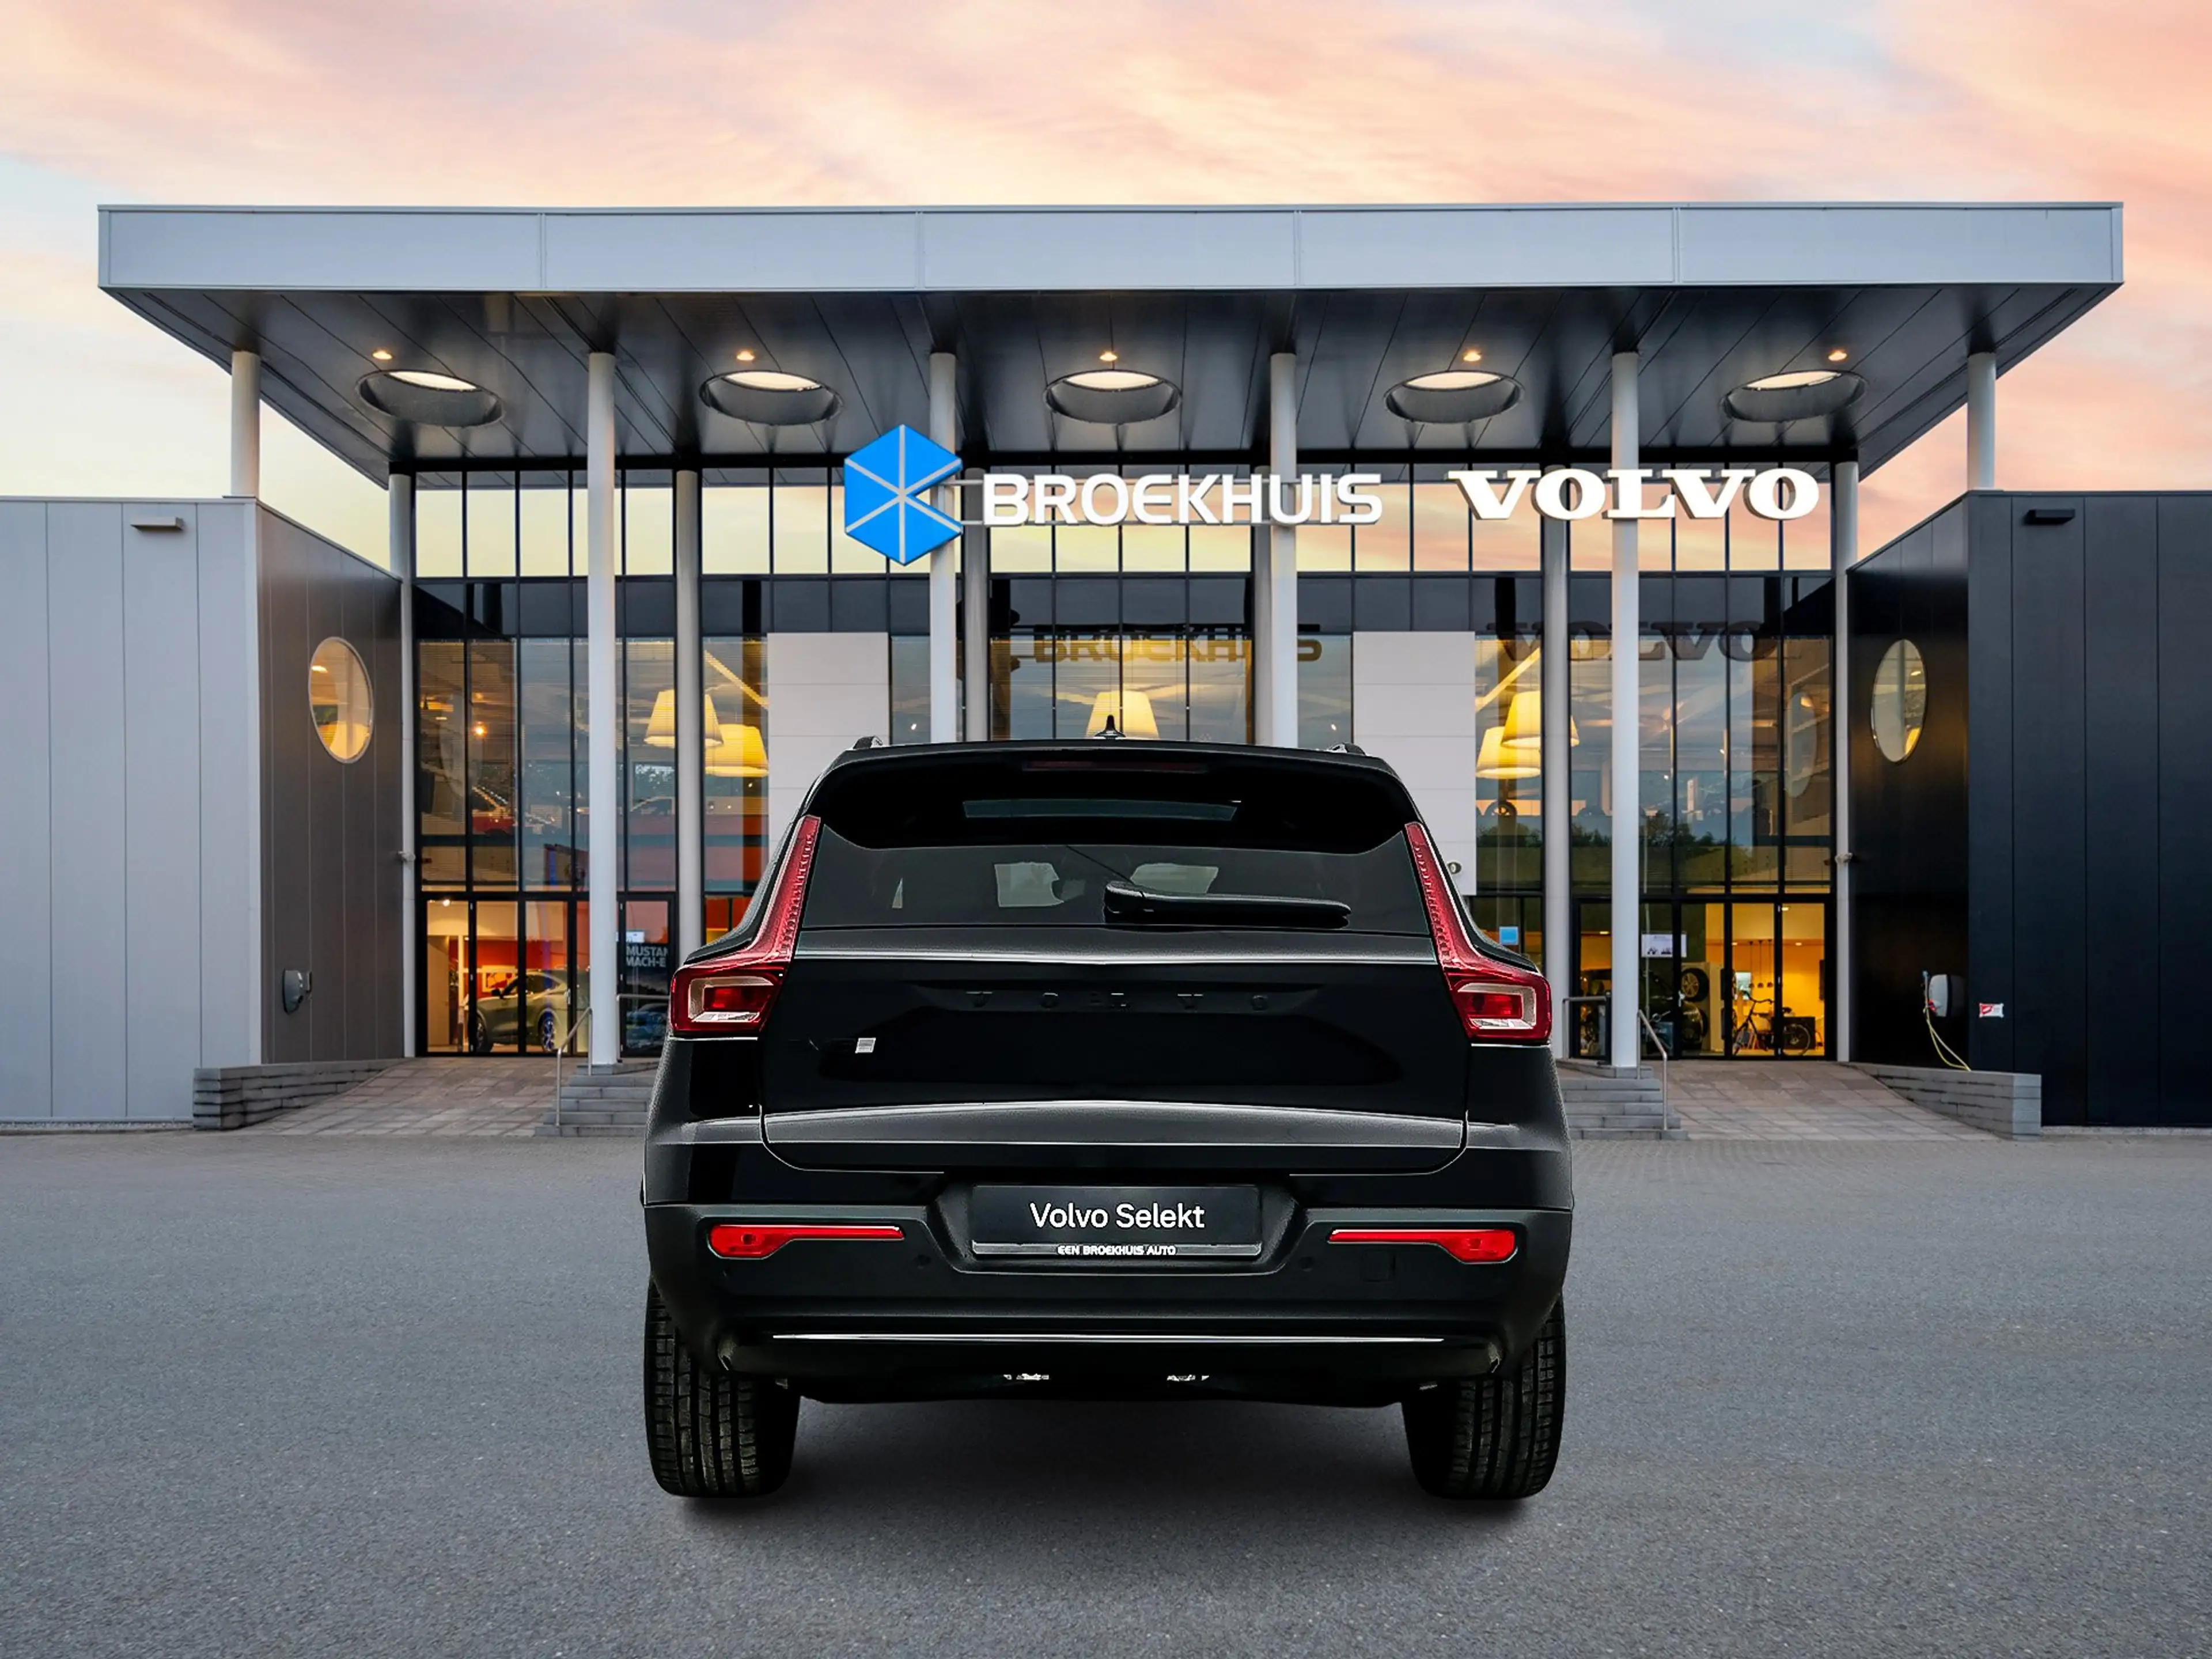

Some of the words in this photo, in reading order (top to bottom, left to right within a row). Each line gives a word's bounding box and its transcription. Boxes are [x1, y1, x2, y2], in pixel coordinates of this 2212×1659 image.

[983, 473, 1382, 525] BROEKHUIS
[1447, 467, 1820, 521] VOLVO
[1029, 1202, 1108, 1229] Volvo
[1115, 1202, 1205, 1229] Selekt
[1057, 1245, 1080, 1255] EEN
[1082, 1245, 1145, 1255] BROEKHUIS
[1146, 1245, 1177, 1255] AUTO
